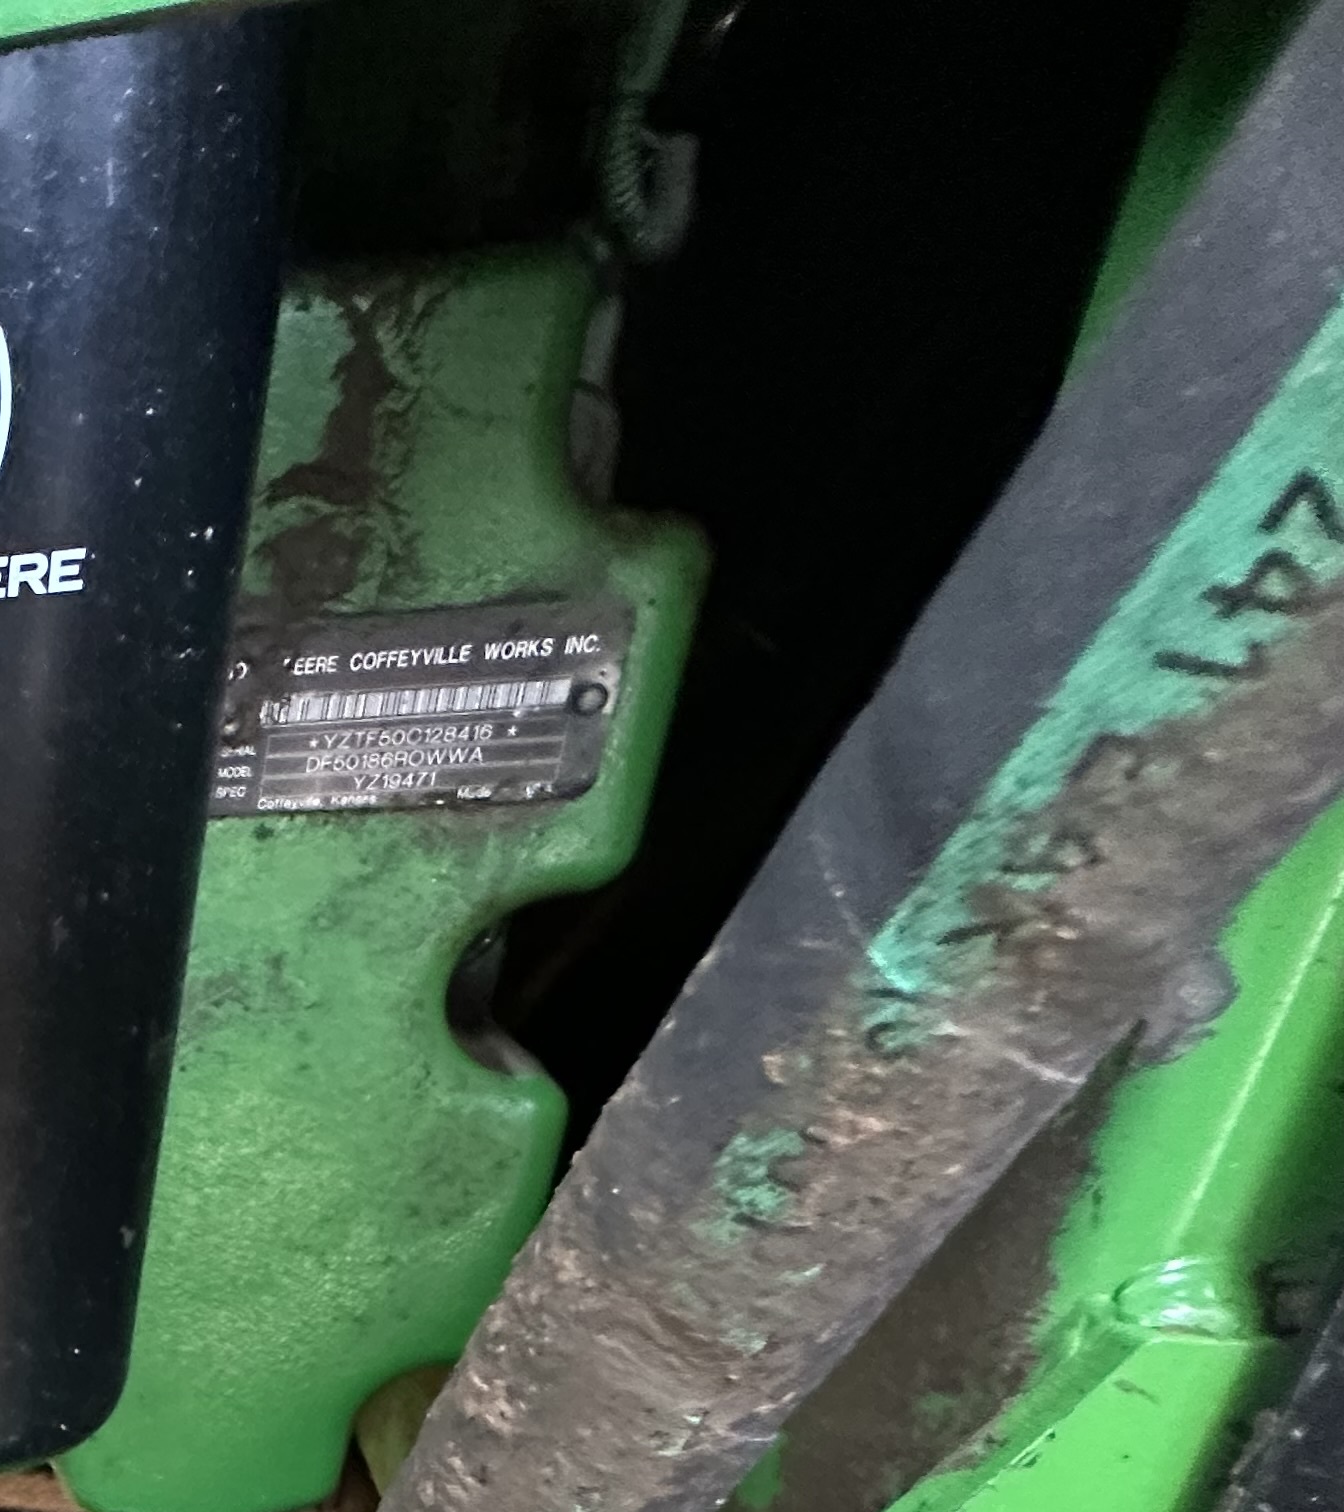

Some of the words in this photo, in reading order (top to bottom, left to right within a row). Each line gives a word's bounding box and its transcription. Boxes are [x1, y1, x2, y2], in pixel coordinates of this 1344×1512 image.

[284, 655, 340, 677] EERE
[350, 644, 474, 672] COFFEYVILLE
[484, 637, 556, 661] WORKS
[564, 634, 602, 655] INC.
[215, 785, 248, 799] SPEC
[353, 772, 437, 792] YZ19471
[216, 765, 253, 779] MODEL
